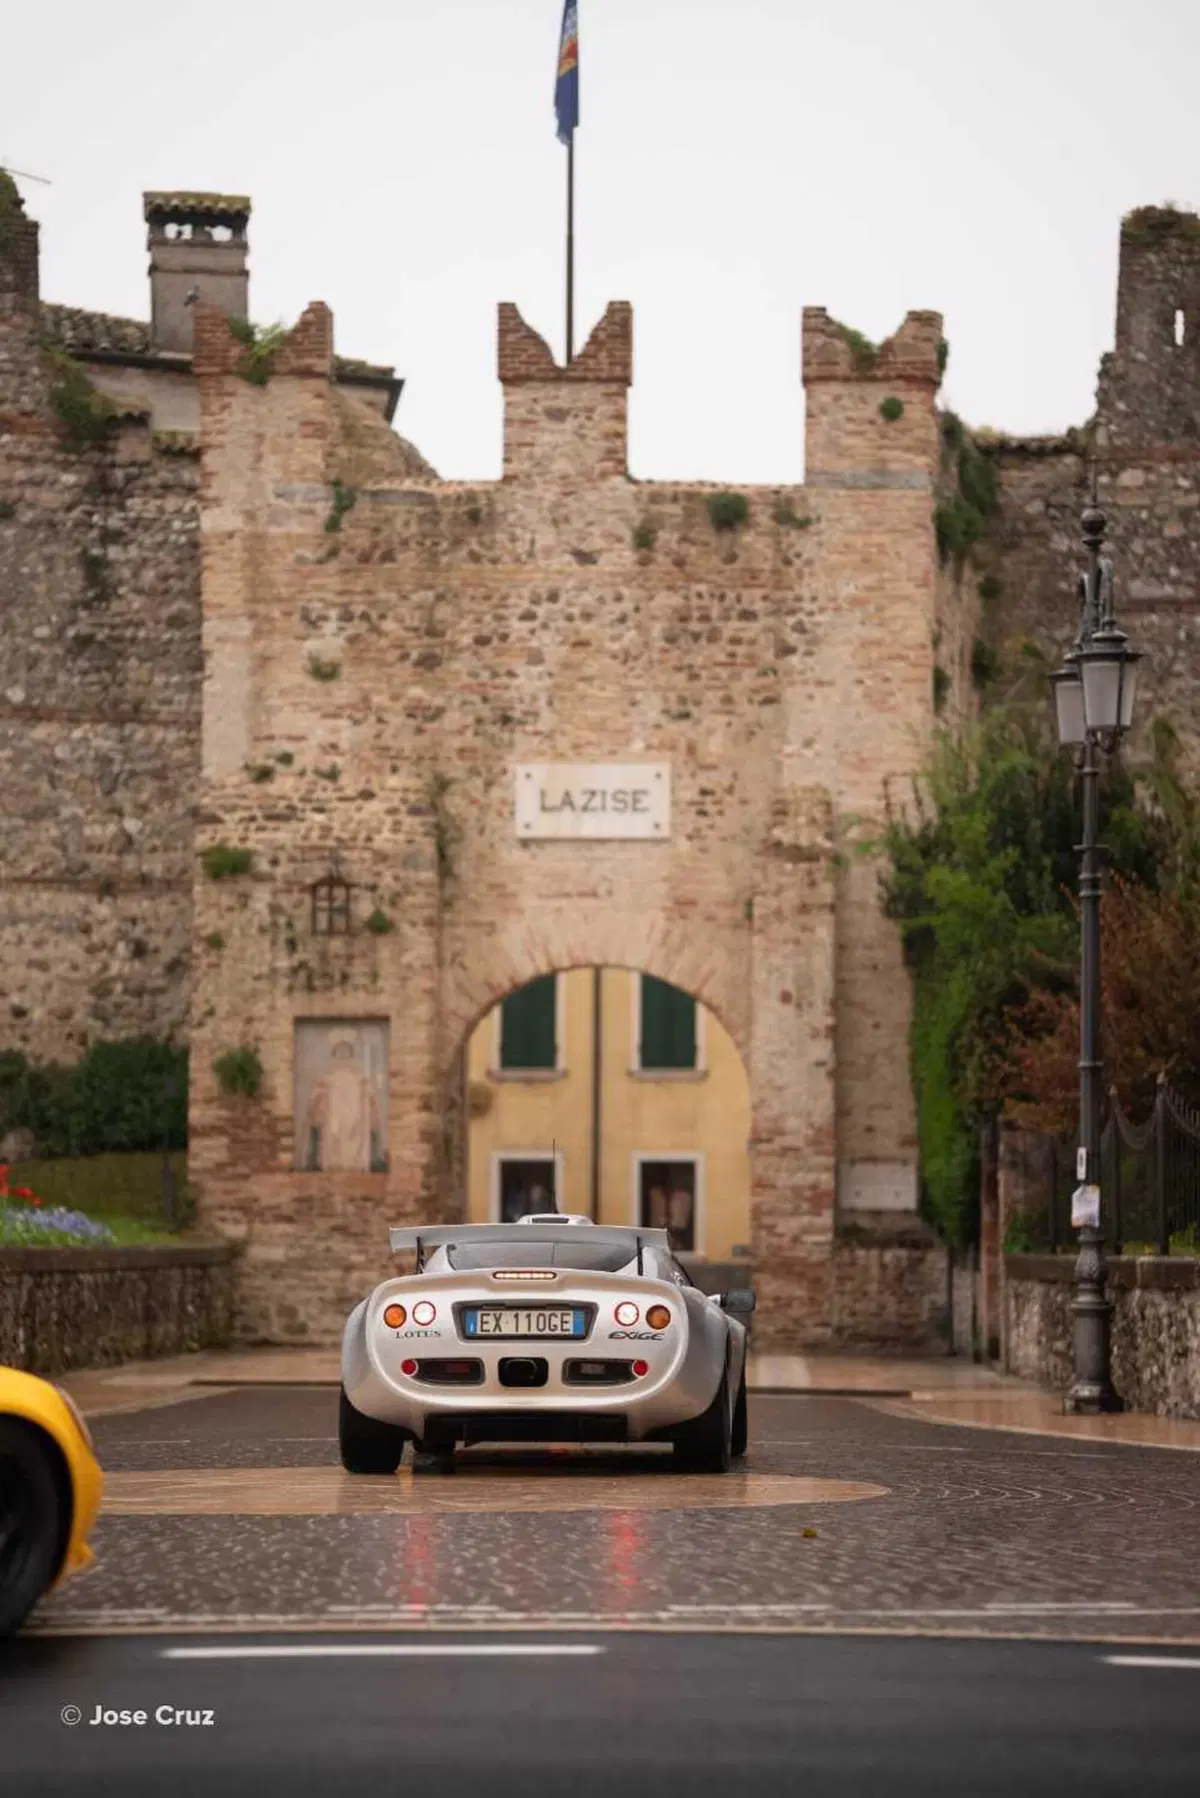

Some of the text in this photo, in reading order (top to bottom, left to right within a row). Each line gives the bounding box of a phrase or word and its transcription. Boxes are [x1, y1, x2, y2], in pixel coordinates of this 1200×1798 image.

[539, 788, 651, 813] LAZISE
[480, 1312, 503, 1333] EX
[513, 1312, 571, 1333] 110GE
[395, 1330, 442, 1340] LOTUS
[608, 1330, 665, 1341] EXIGE
